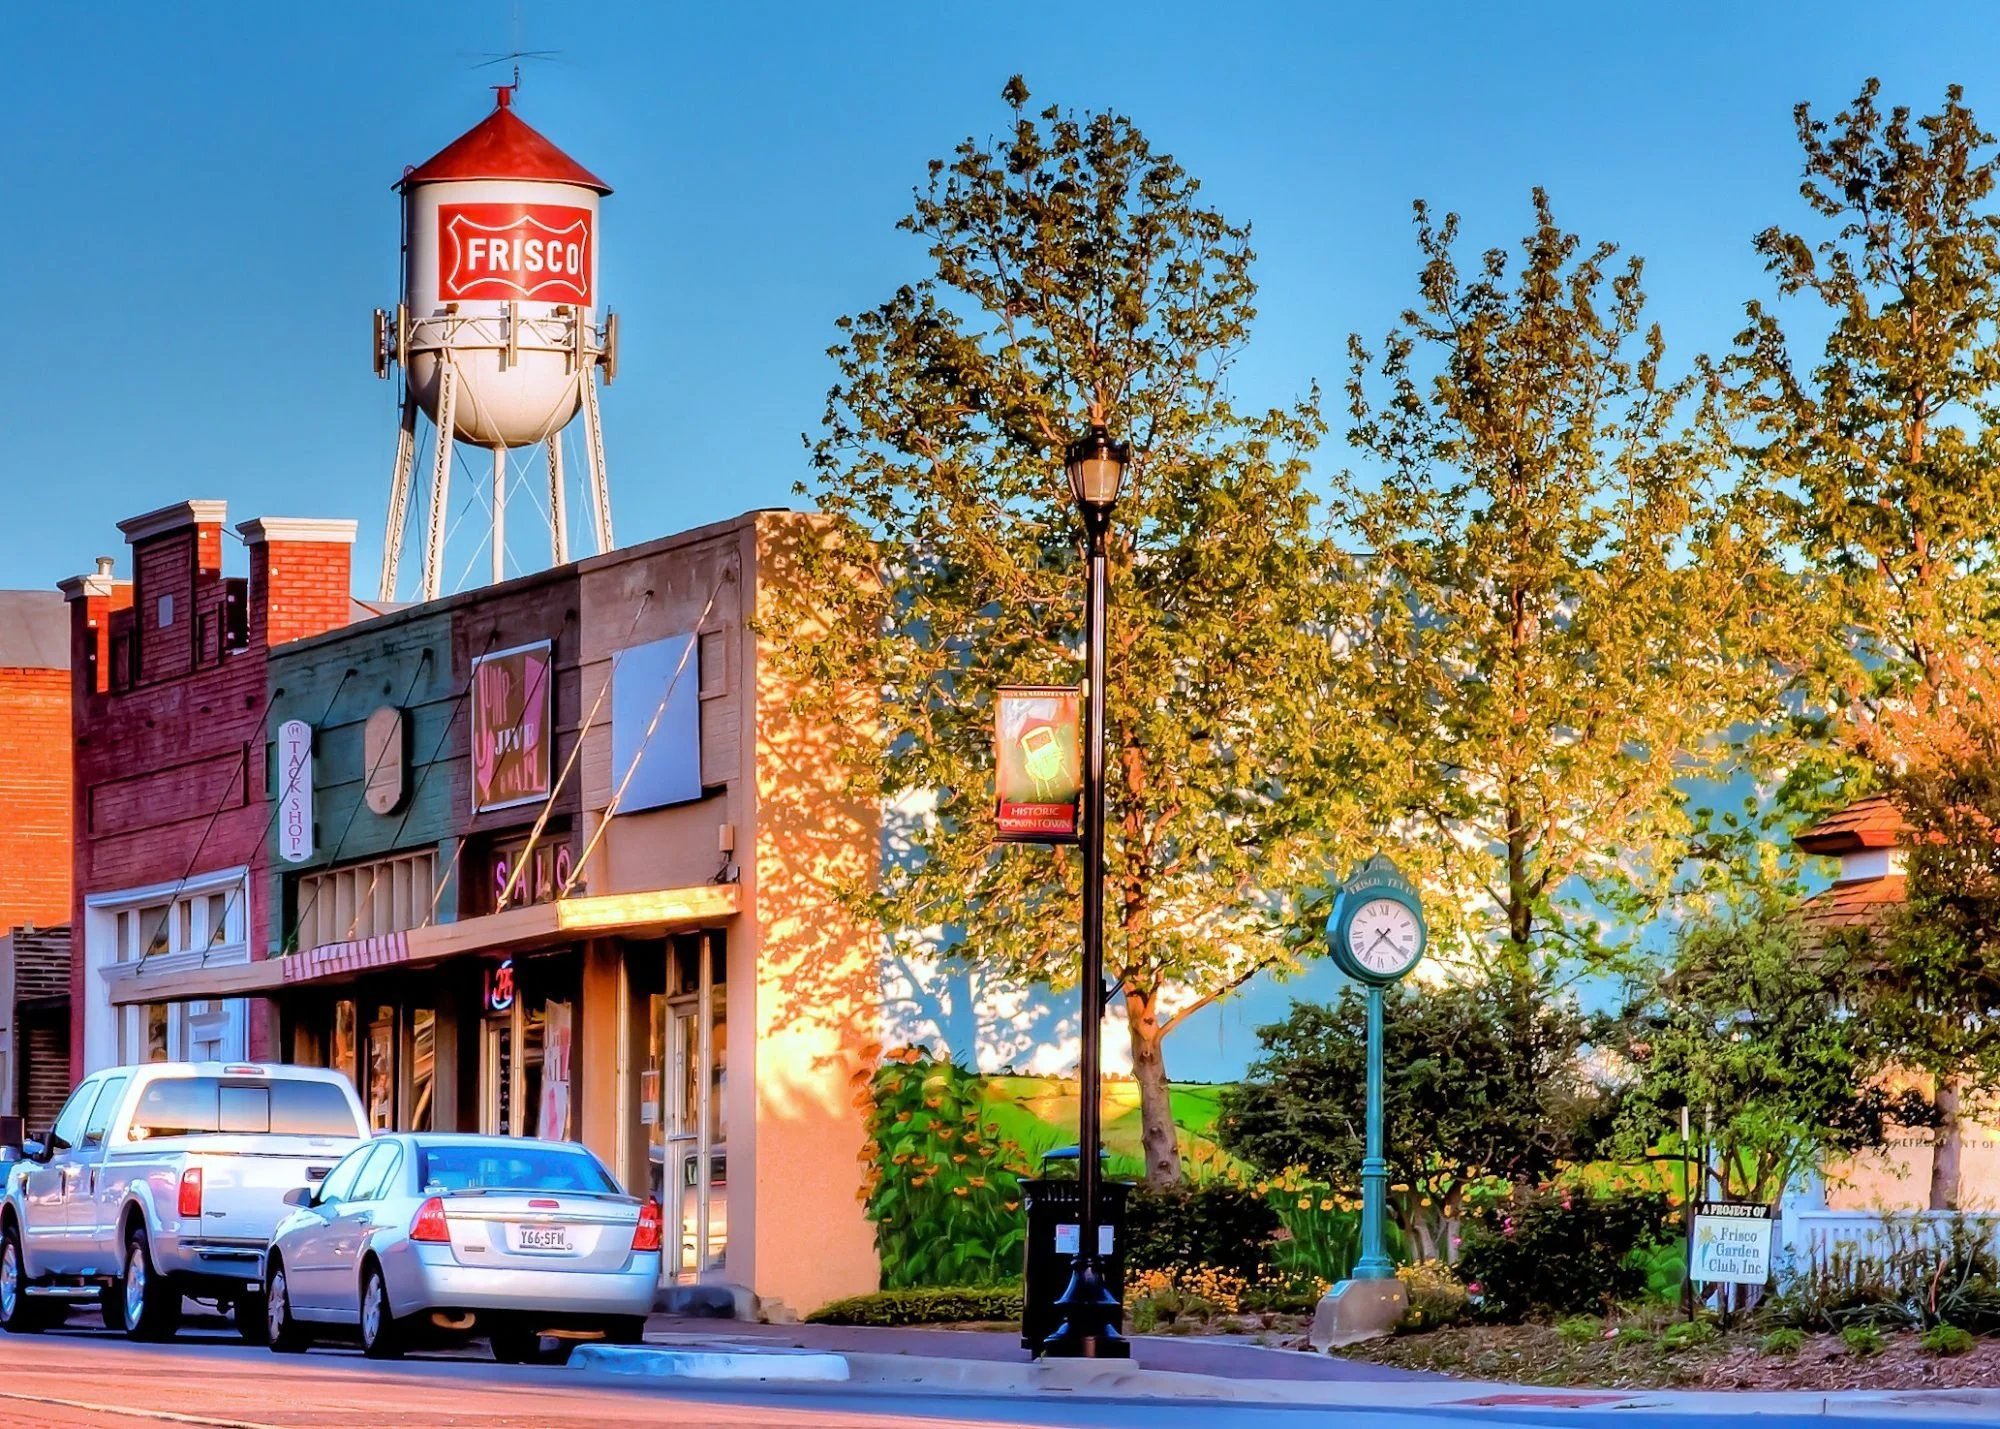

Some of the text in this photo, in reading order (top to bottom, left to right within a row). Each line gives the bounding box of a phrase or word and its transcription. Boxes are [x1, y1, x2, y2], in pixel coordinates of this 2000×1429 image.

[468, 237, 579, 276] FRISCO
[475, 663, 510, 768] JUMP
[495, 723, 534, 756] JIVE
[288, 741, 303, 794] TACK
[1011, 807, 1060, 817] HISTORIC
[288, 798, 303, 850] SHOP
[1002, 819, 1070, 828] DOWNTOWN
[1702, 1204, 1767, 1218] A PROJECT OF
[1720, 1227, 1758, 1242] Frisco
[1716, 1243, 1759, 1258] Garden
[1709, 1259, 1764, 1275] Club, Inc.
